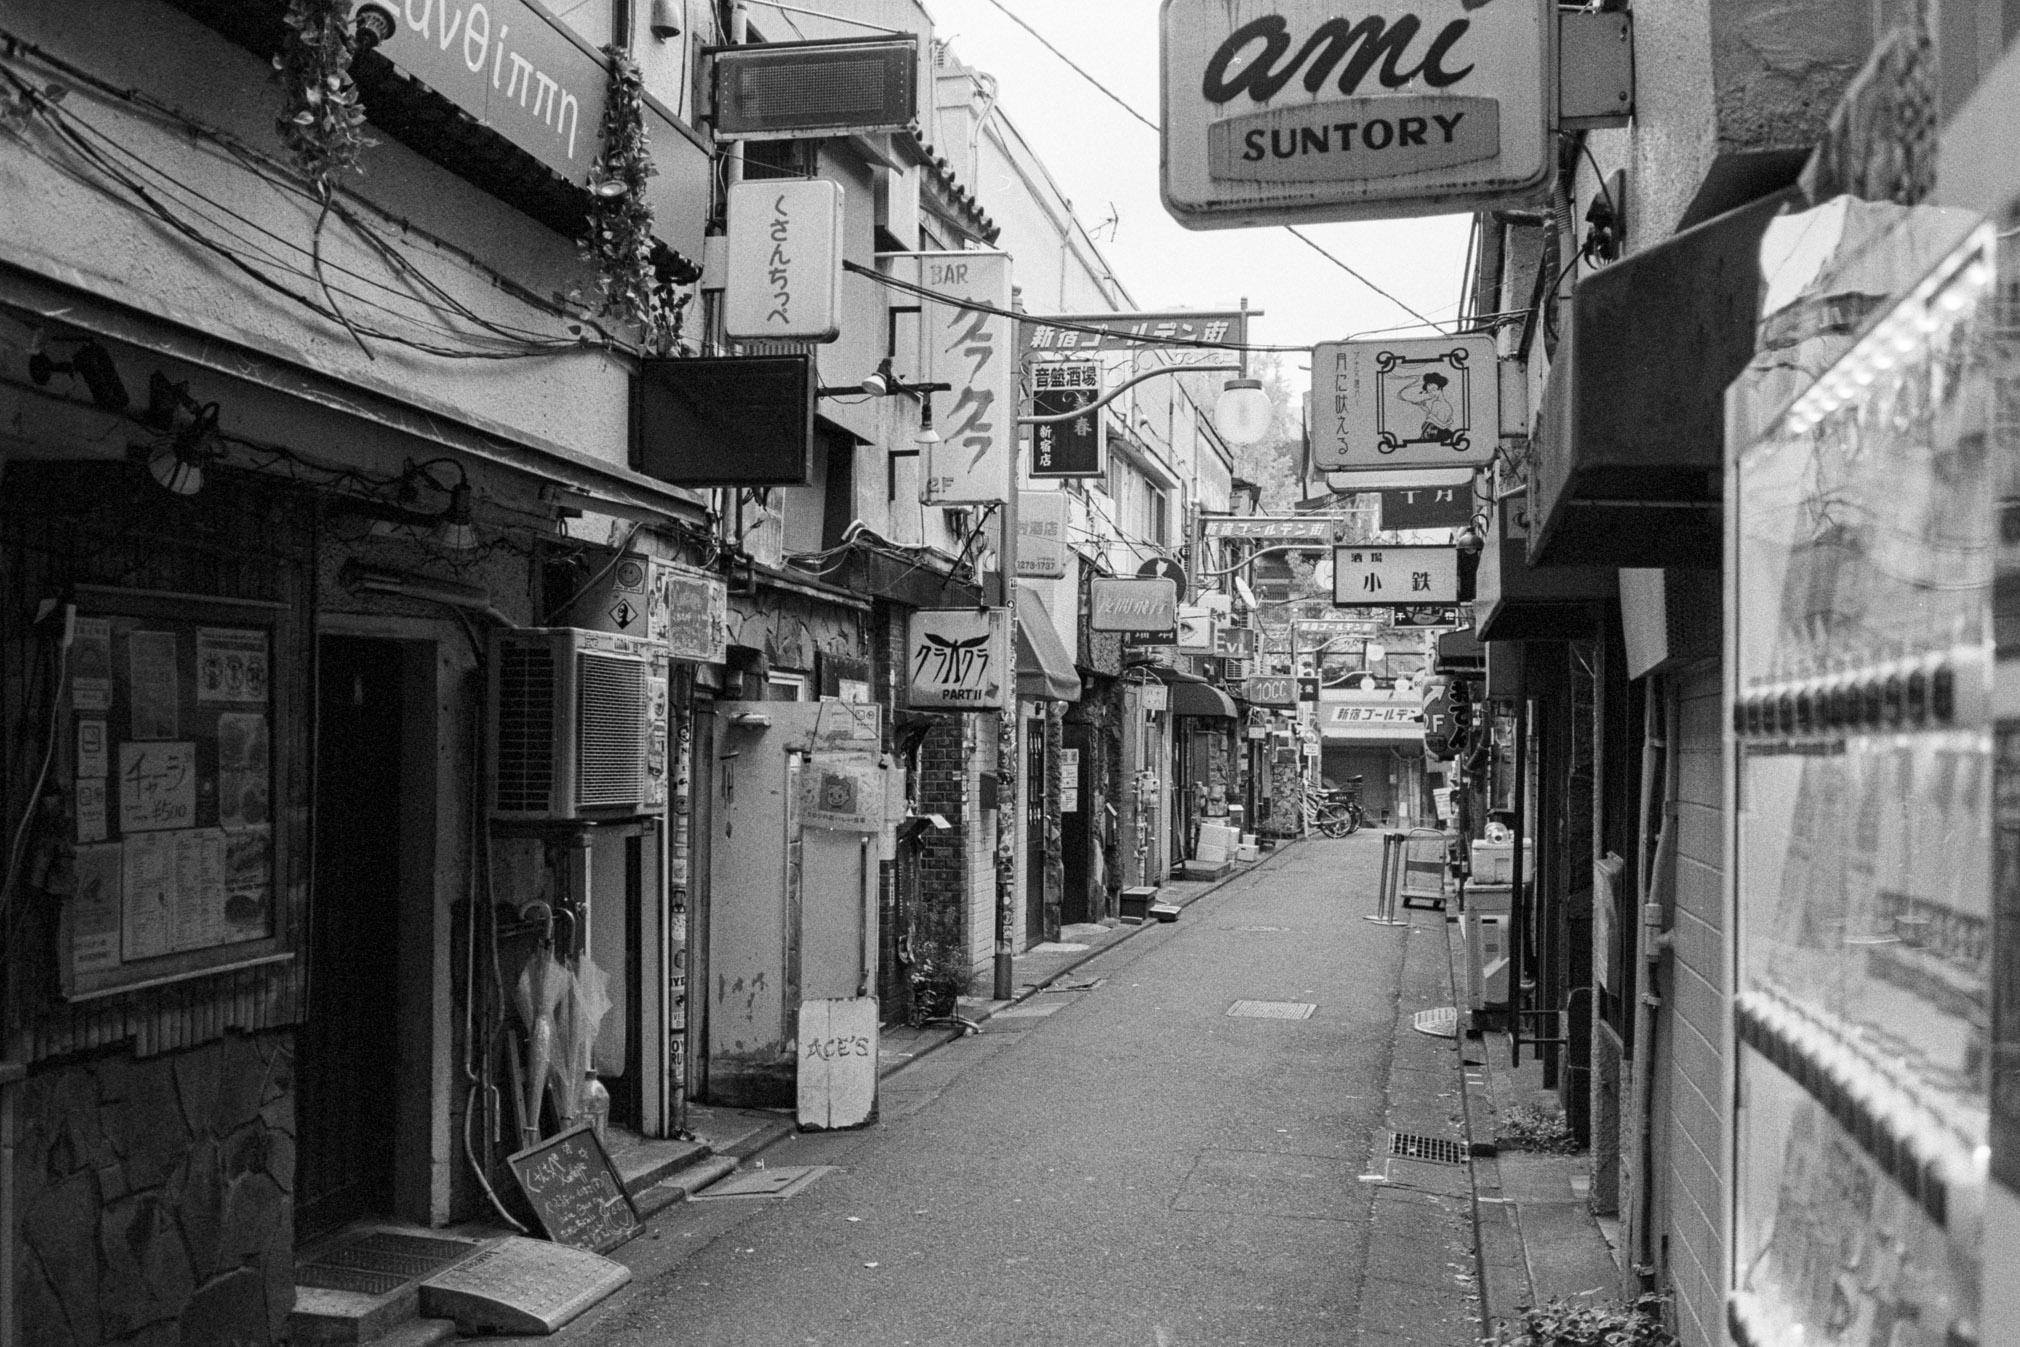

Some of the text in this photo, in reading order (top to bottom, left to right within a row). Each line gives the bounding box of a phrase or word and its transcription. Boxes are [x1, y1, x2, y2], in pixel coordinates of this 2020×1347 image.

[1203, 0, 1492, 104] ami
[1241, 111, 1466, 162] SUNTORY
[929, 263, 969, 286] BAR
[1030, 321, 1229, 348] 新宿ゴールデン街
[944, 296, 995, 475] クラクラ
[1034, 366, 1098, 389] 音盤酒場
[1335, 352, 1350, 456] 月に吠える
[1039, 425, 1053, 467] 新宿店
[1204, 522, 1325, 536] 新宿ゴールデン街
[1363, 571, 1431, 593] 小鉄
[942, 689, 974, 701] PART
[805, 1034, 870, 1062] ACE'S
